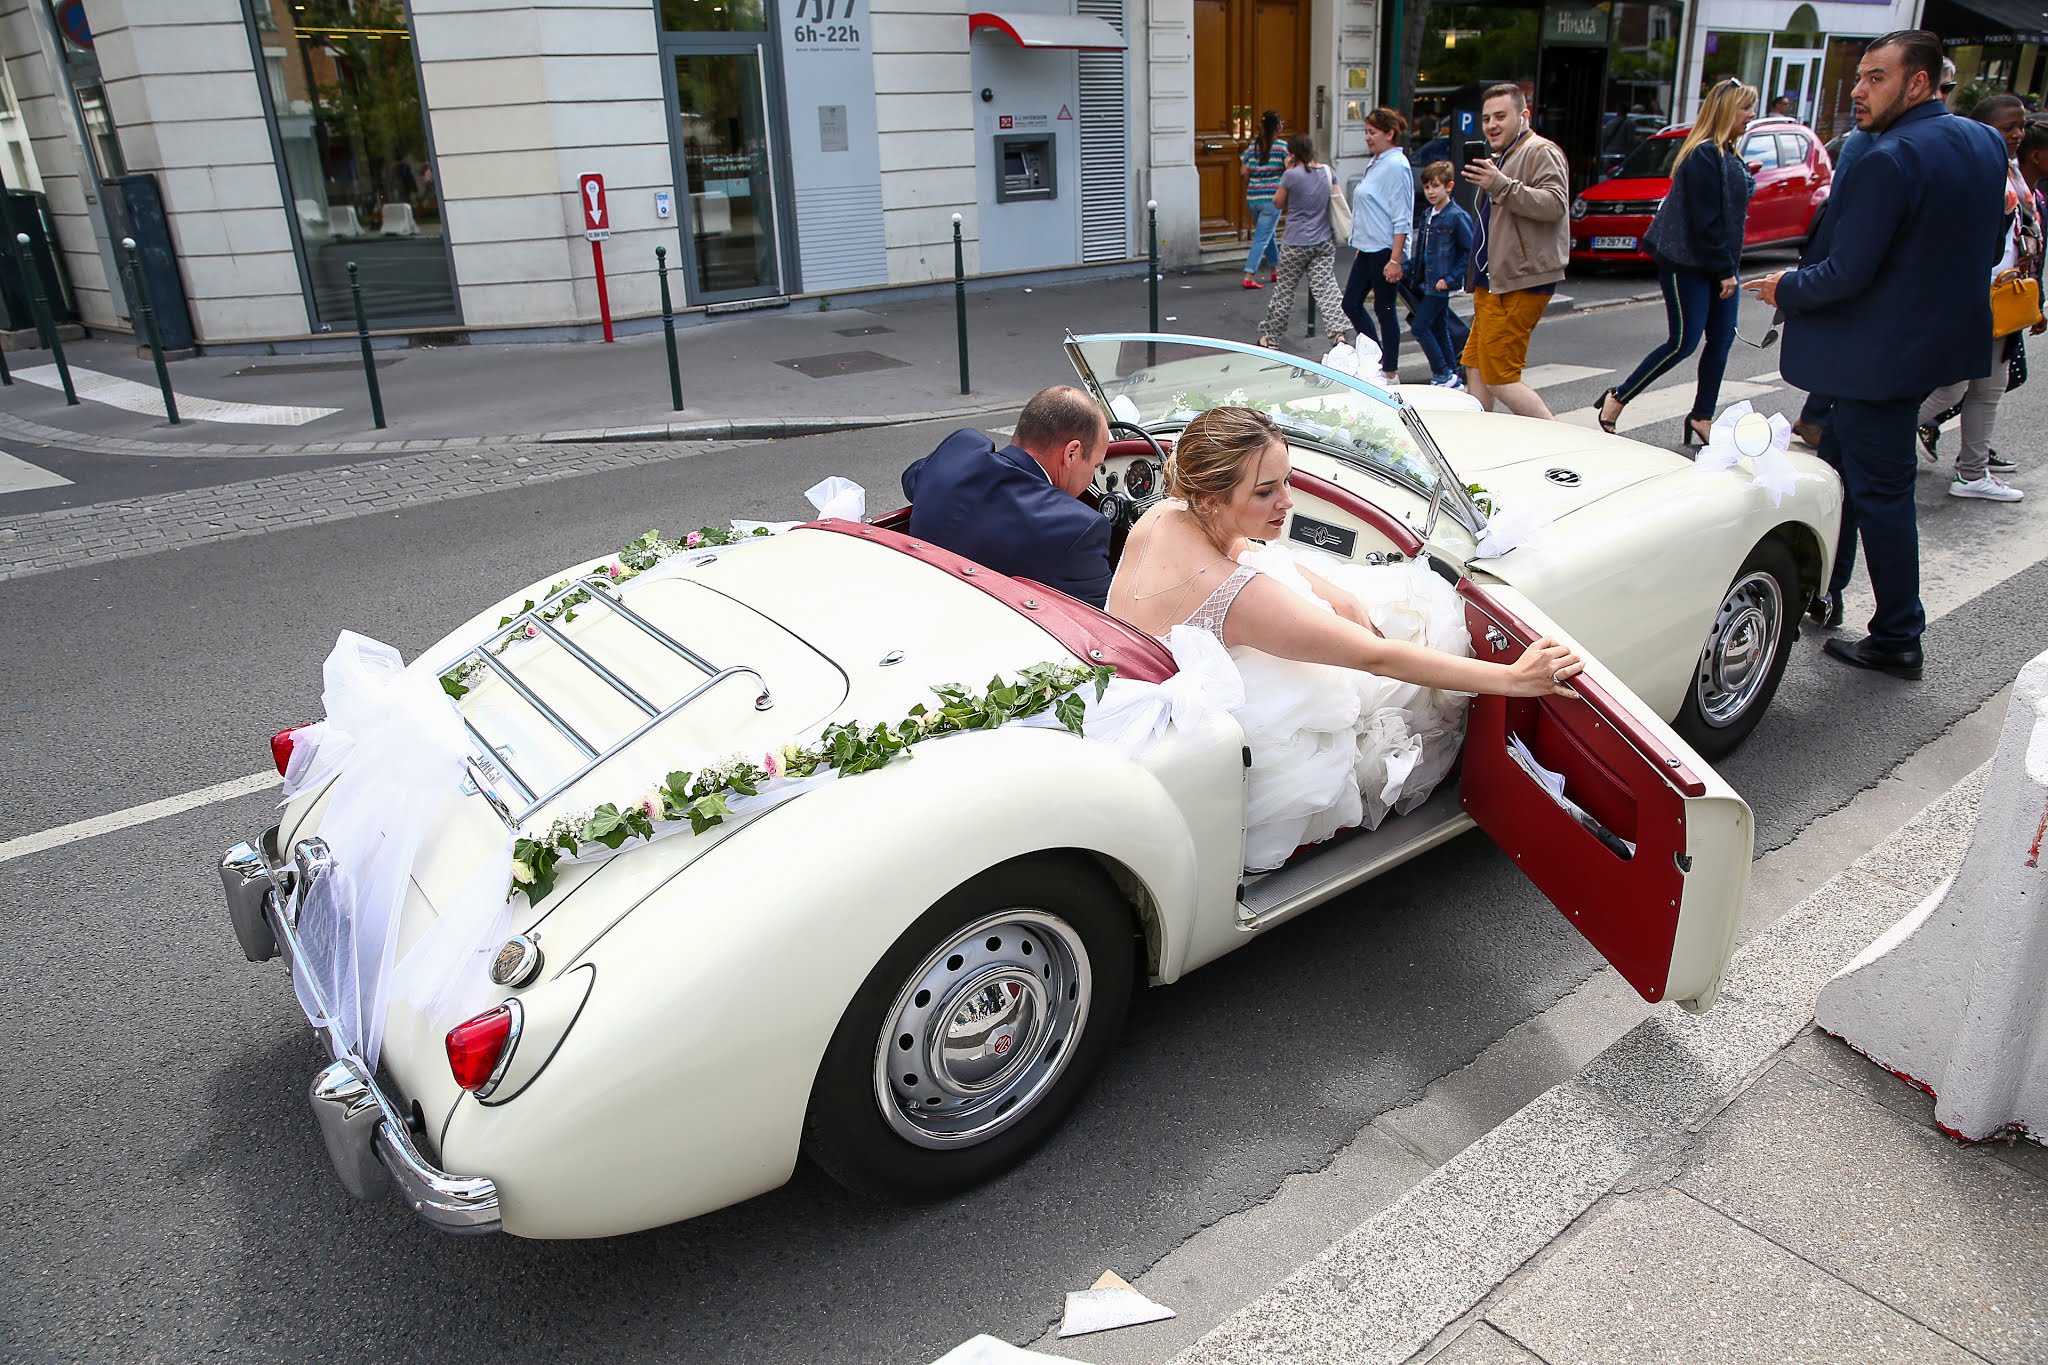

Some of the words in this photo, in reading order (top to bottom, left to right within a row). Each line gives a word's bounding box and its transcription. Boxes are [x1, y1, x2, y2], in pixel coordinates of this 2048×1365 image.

[794, 25, 860, 42] 6h-22h
[1462, 113, 1472, 131] P
[995, 1036, 1011, 1053] MG
